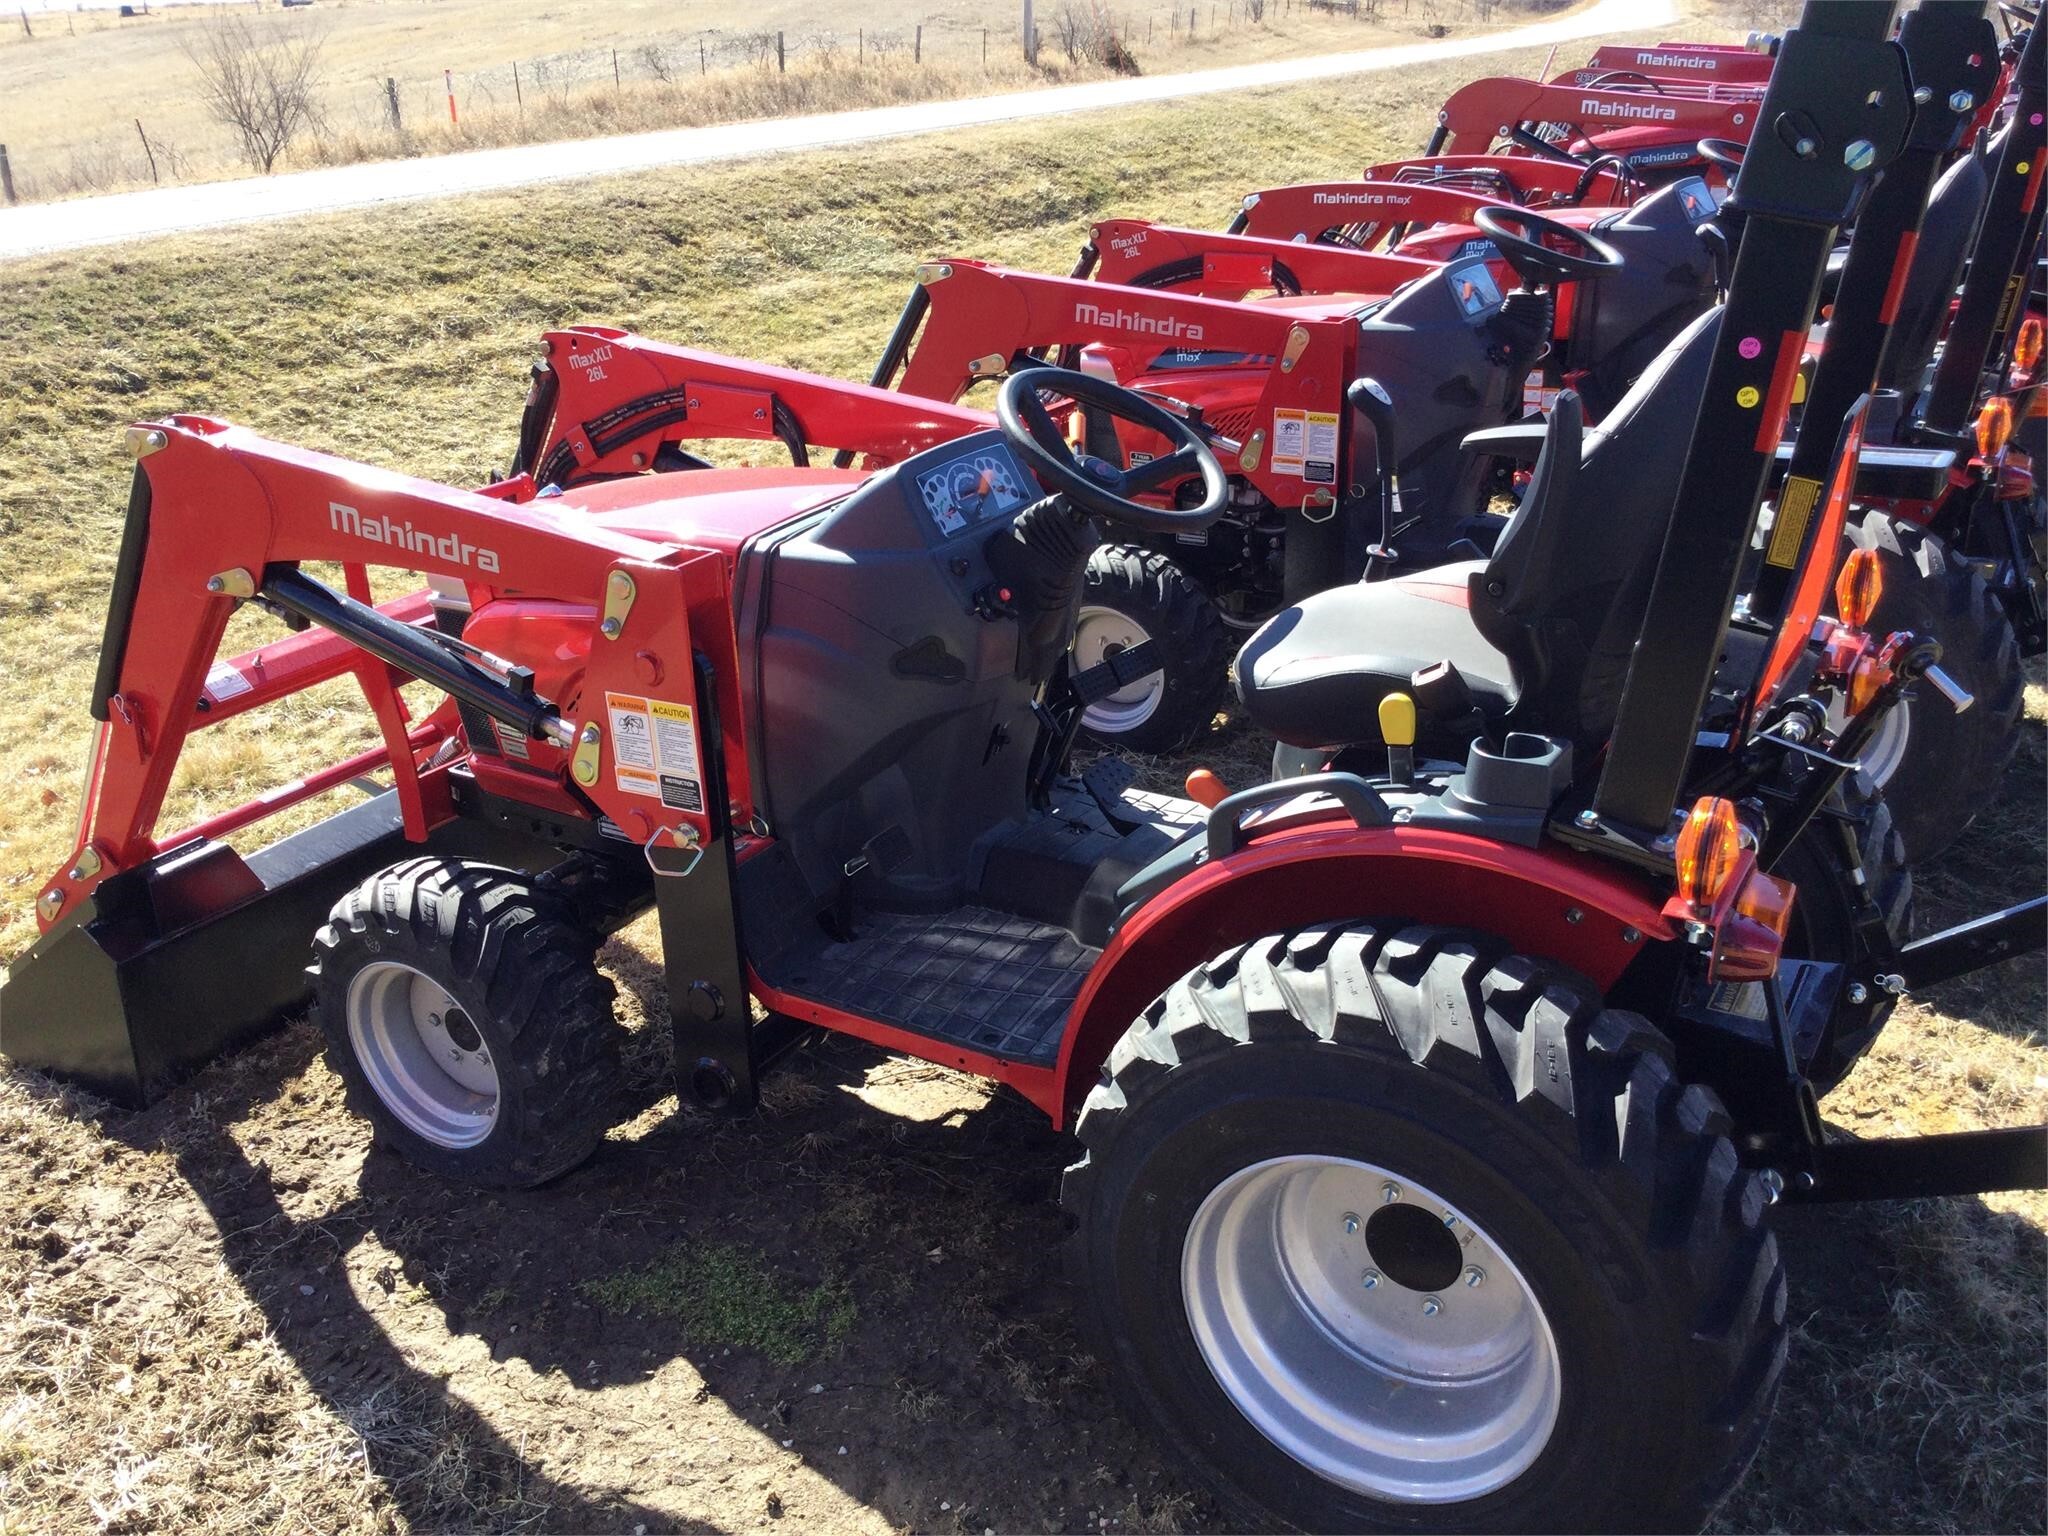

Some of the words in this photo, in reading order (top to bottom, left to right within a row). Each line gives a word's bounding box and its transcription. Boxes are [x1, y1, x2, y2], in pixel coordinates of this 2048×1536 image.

[1636, 52, 1717, 70] Mahindra
[1580, 99, 1676, 121] Mahindra
[1629, 151, 1689, 165] Mahindra
[1313, 192, 1383, 204] Mahindra
[1110, 230, 1148, 250] MaxXLT
[1123, 245, 1141, 259] 26L
[1075, 303, 1204, 341] Mahindra
[568, 344, 614, 370] MaxXLT
[586, 365, 608, 383] 26L
[329, 501, 500, 574] Mahindra
[617, 702, 647, 713] WARNING
[658, 706, 690, 720] CAUTION
